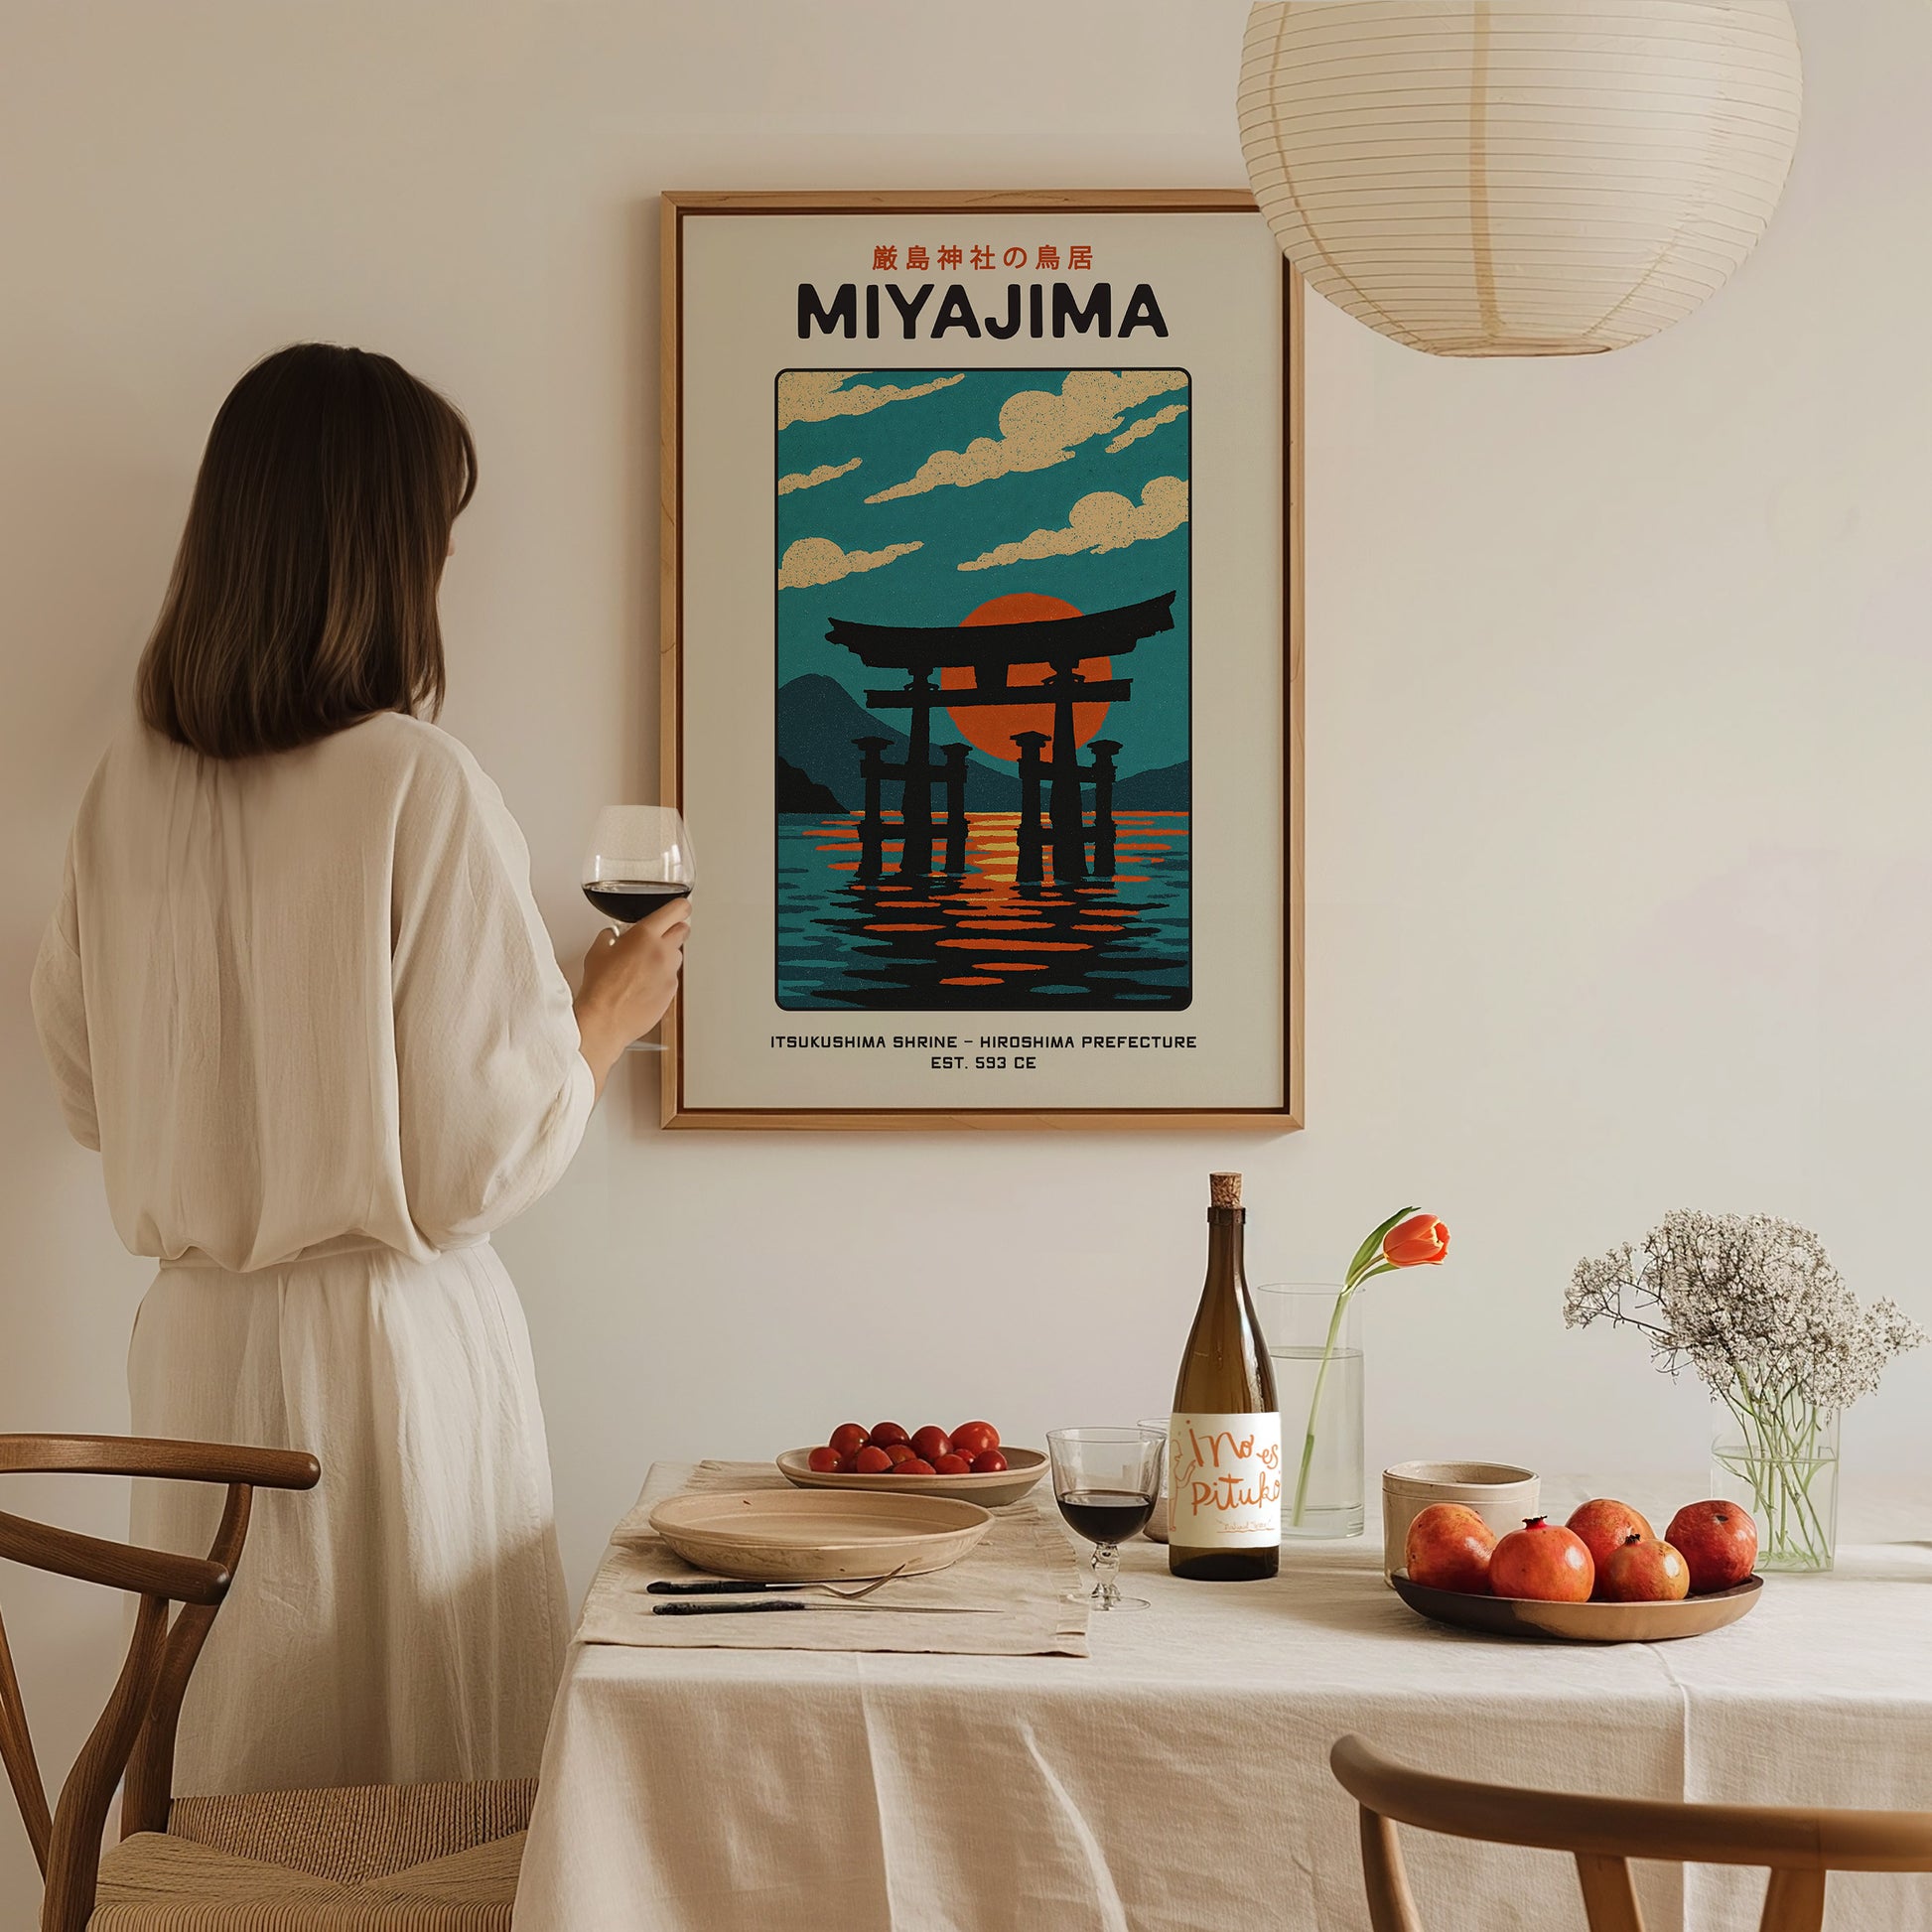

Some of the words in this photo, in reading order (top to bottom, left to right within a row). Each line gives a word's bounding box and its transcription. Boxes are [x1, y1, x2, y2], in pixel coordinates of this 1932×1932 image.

[872, 244, 1094, 271] 厳島神社の鳥居
[797, 282, 1170, 341] MIYAJIMA
[770, 1035, 887, 1048] ITSUKUSHIMA
[893, 1035, 958, 1048] SHRINE
[980, 1035, 1075, 1048] HIROSHIMA
[1081, 1035, 1197, 1048] PREFECTURE
[930, 1056, 969, 1069] EST.
[975, 1056, 1007, 1069] 593
[1014, 1056, 1036, 1069] CE
